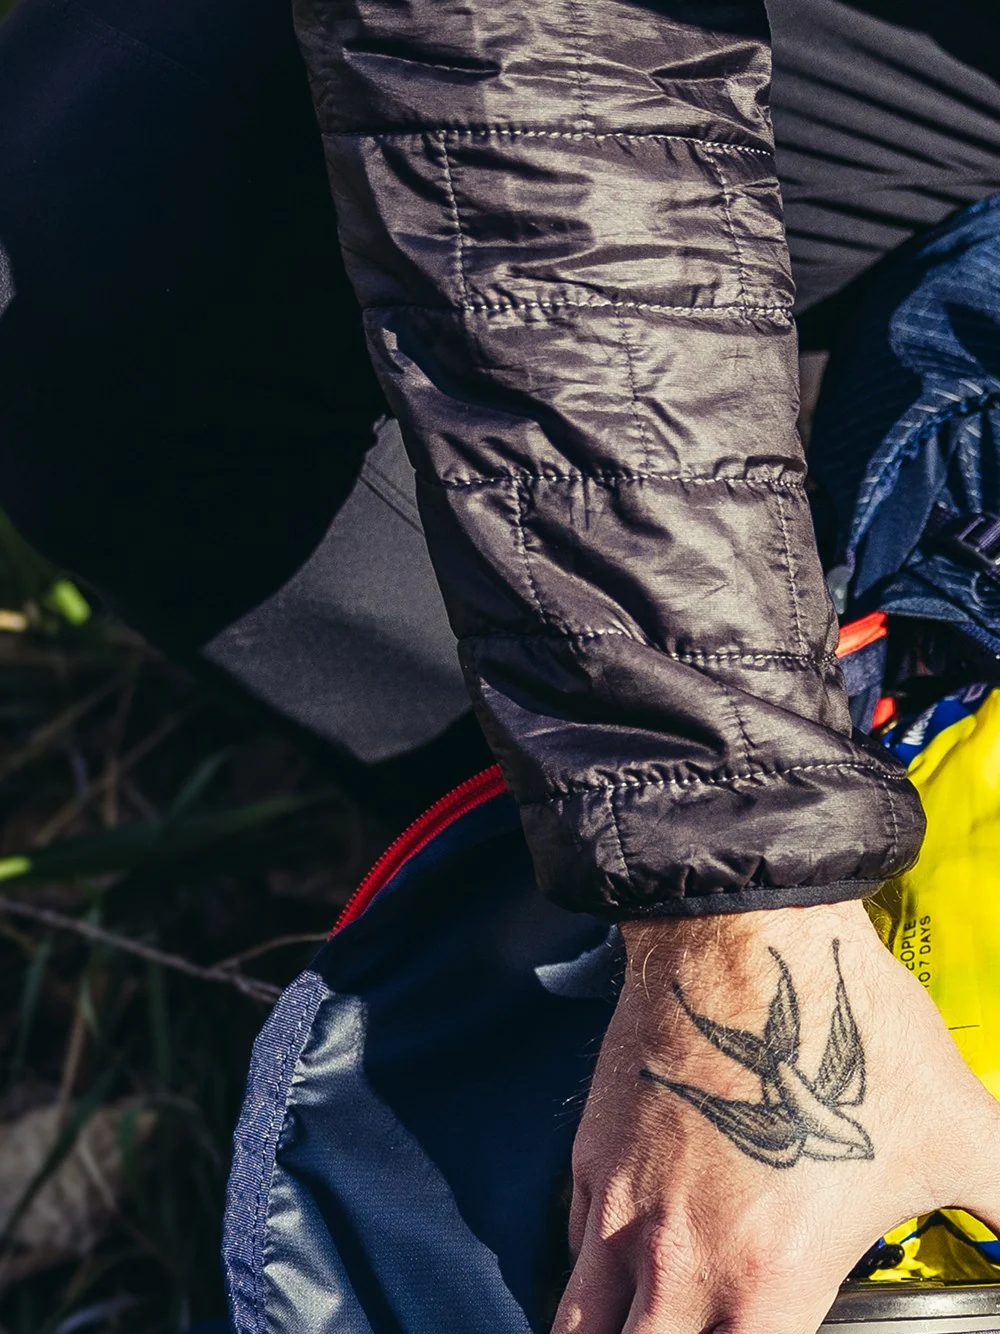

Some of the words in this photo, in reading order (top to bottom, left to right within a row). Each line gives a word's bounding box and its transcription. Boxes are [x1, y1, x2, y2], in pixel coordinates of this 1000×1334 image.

[901, 919, 916, 971] EOPLE
[919, 915, 931, 955] DAYS
[919, 960, 930, 968] 7
